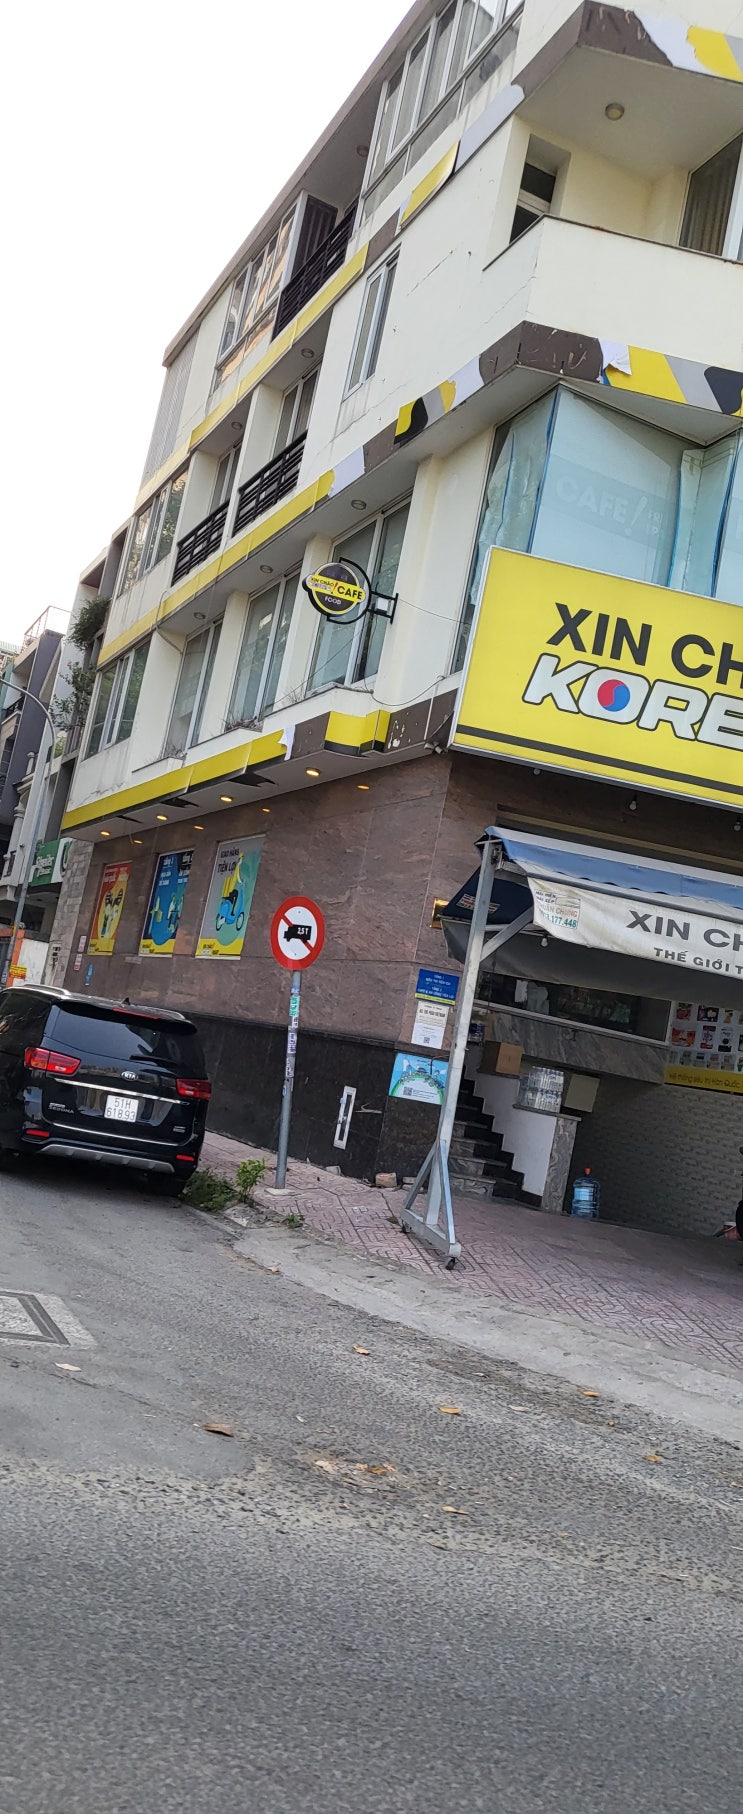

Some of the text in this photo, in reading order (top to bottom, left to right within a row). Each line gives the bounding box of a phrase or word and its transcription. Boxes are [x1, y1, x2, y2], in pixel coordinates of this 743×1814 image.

[337, 585, 363, 600] CAFE
[324, 596, 342, 605] FOOD
[546, 602, 743, 690] XIN CH
[555, 907, 578, 918] CHUNG
[626, 910, 690, 941] XIN
[653, 947, 688, 963] THẾ
[693, 957, 730, 972] GIỚI
[114, 1097, 132, 1110] 51H
